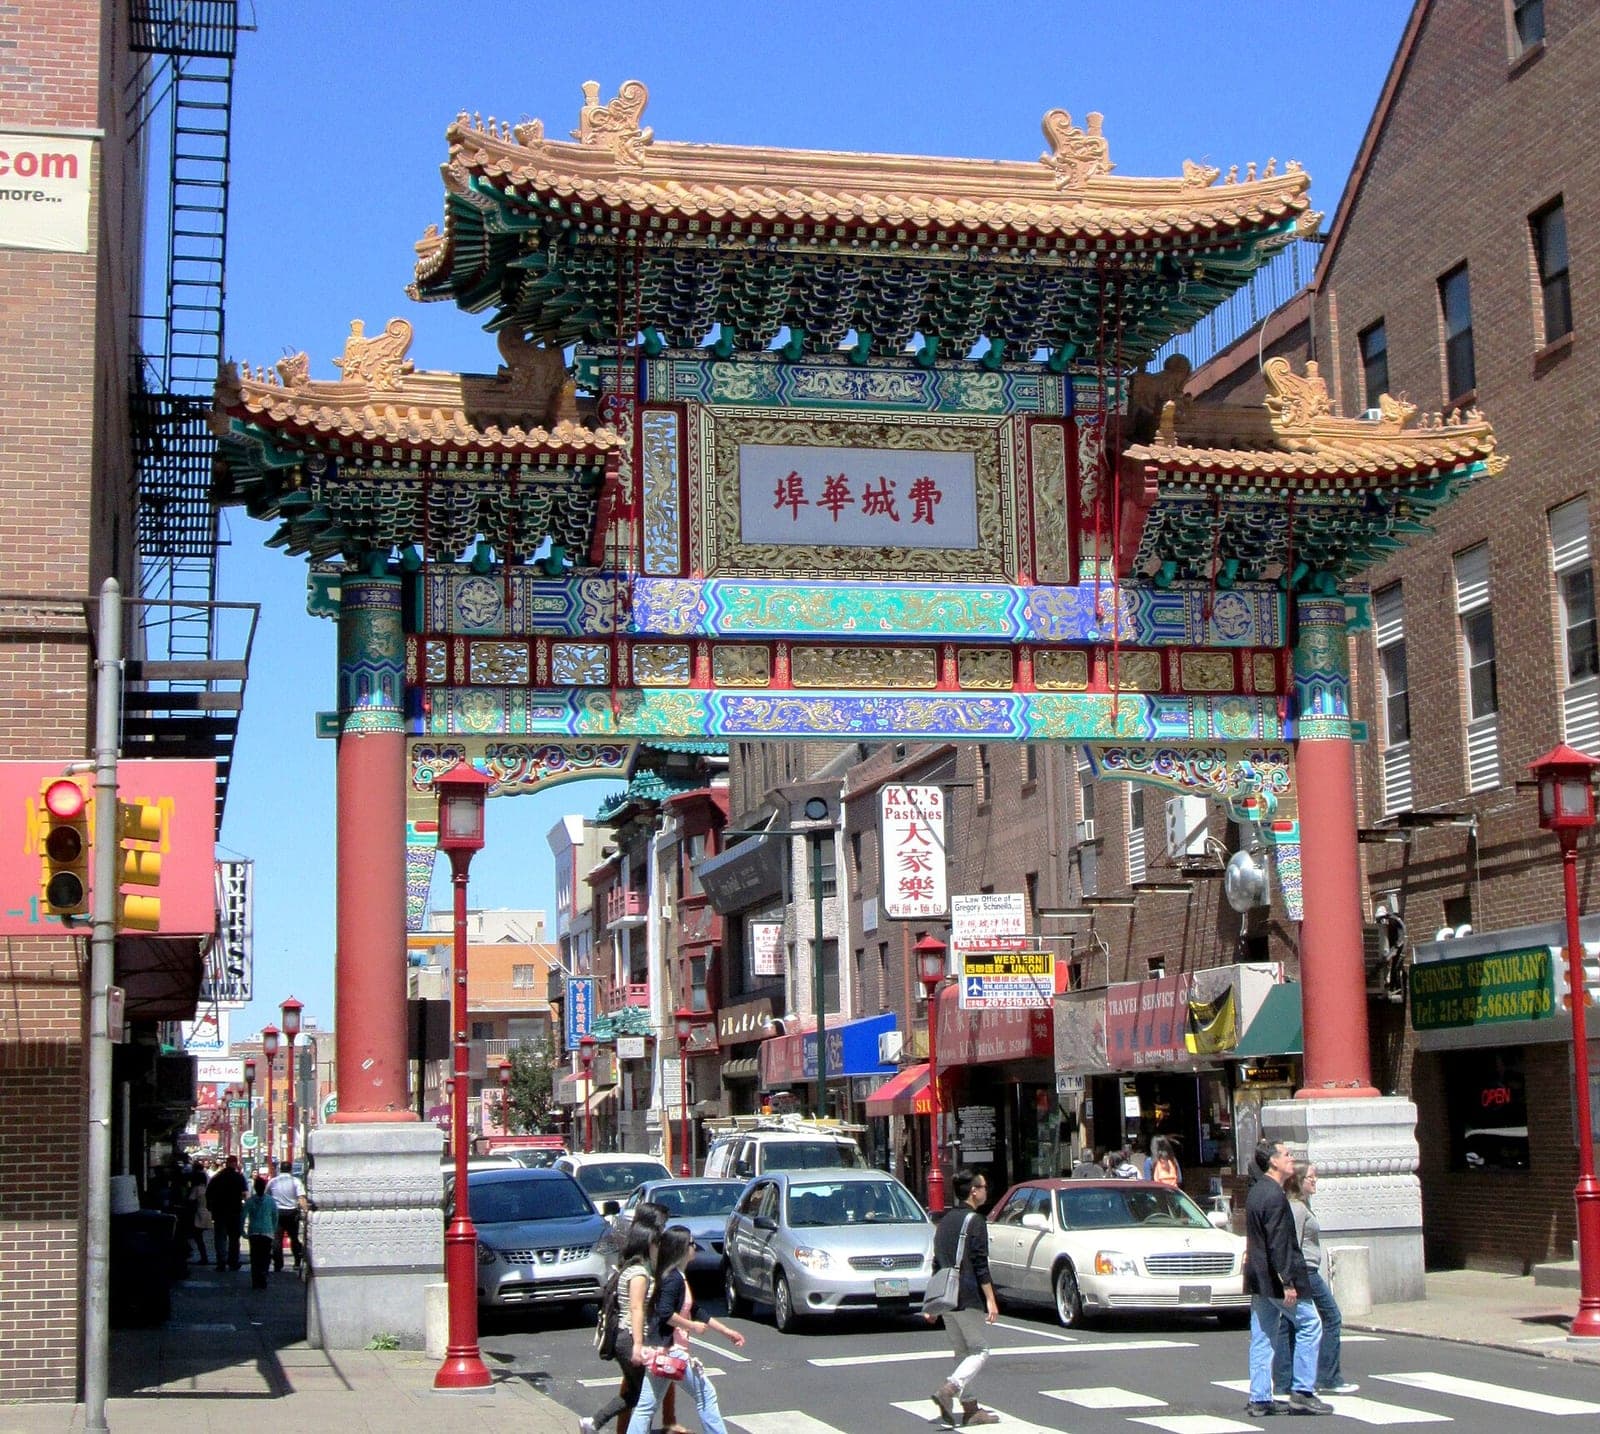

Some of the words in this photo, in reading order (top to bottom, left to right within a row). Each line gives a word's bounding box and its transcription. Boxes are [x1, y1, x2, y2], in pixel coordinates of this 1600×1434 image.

[886, 788, 939, 806] K.C.'s
[885, 807, 942, 820] Pastries
[896, 822, 935, 901] 大家樂
[954, 903, 980, 912] Gregory
[227, 863, 246, 979] EMPRESS
[993, 955, 1042, 965] WESTERN
[1011, 964, 1042, 974] UNION
[1415, 967, 1461, 993] CHINESE
[1468, 953, 1547, 986] RESTAURANT
[1109, 997, 1137, 1016] TRAVEL
[1142, 991, 1175, 1011] SERVICE
[1060, 1076, 1083, 1089] ATM
[1481, 1087, 1511, 1107] OPEN
